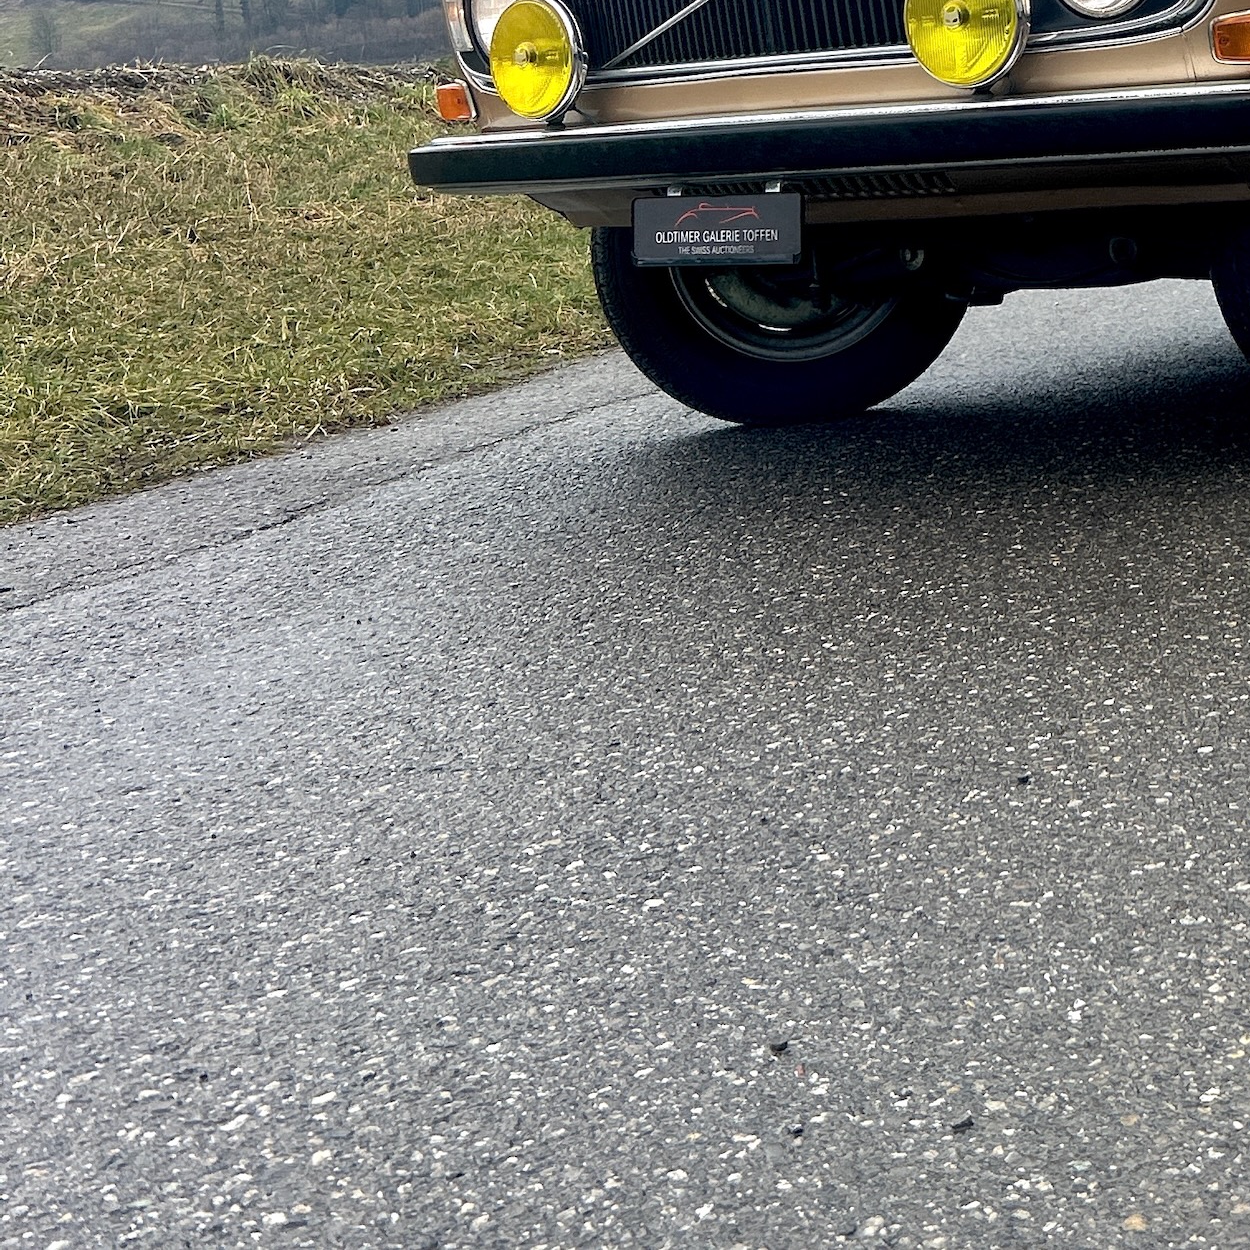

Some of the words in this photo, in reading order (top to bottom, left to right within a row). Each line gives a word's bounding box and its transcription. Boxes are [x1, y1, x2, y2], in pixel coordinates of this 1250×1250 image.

[655, 231, 700, 243] OLDTIMER
[702, 230, 740, 242] GALERIE
[743, 229, 778, 241] TOFFEN
[678, 246, 690, 254] THE
[691, 245, 711, 254] SWISS
[711, 245, 755, 254] AUCTIONEERS
